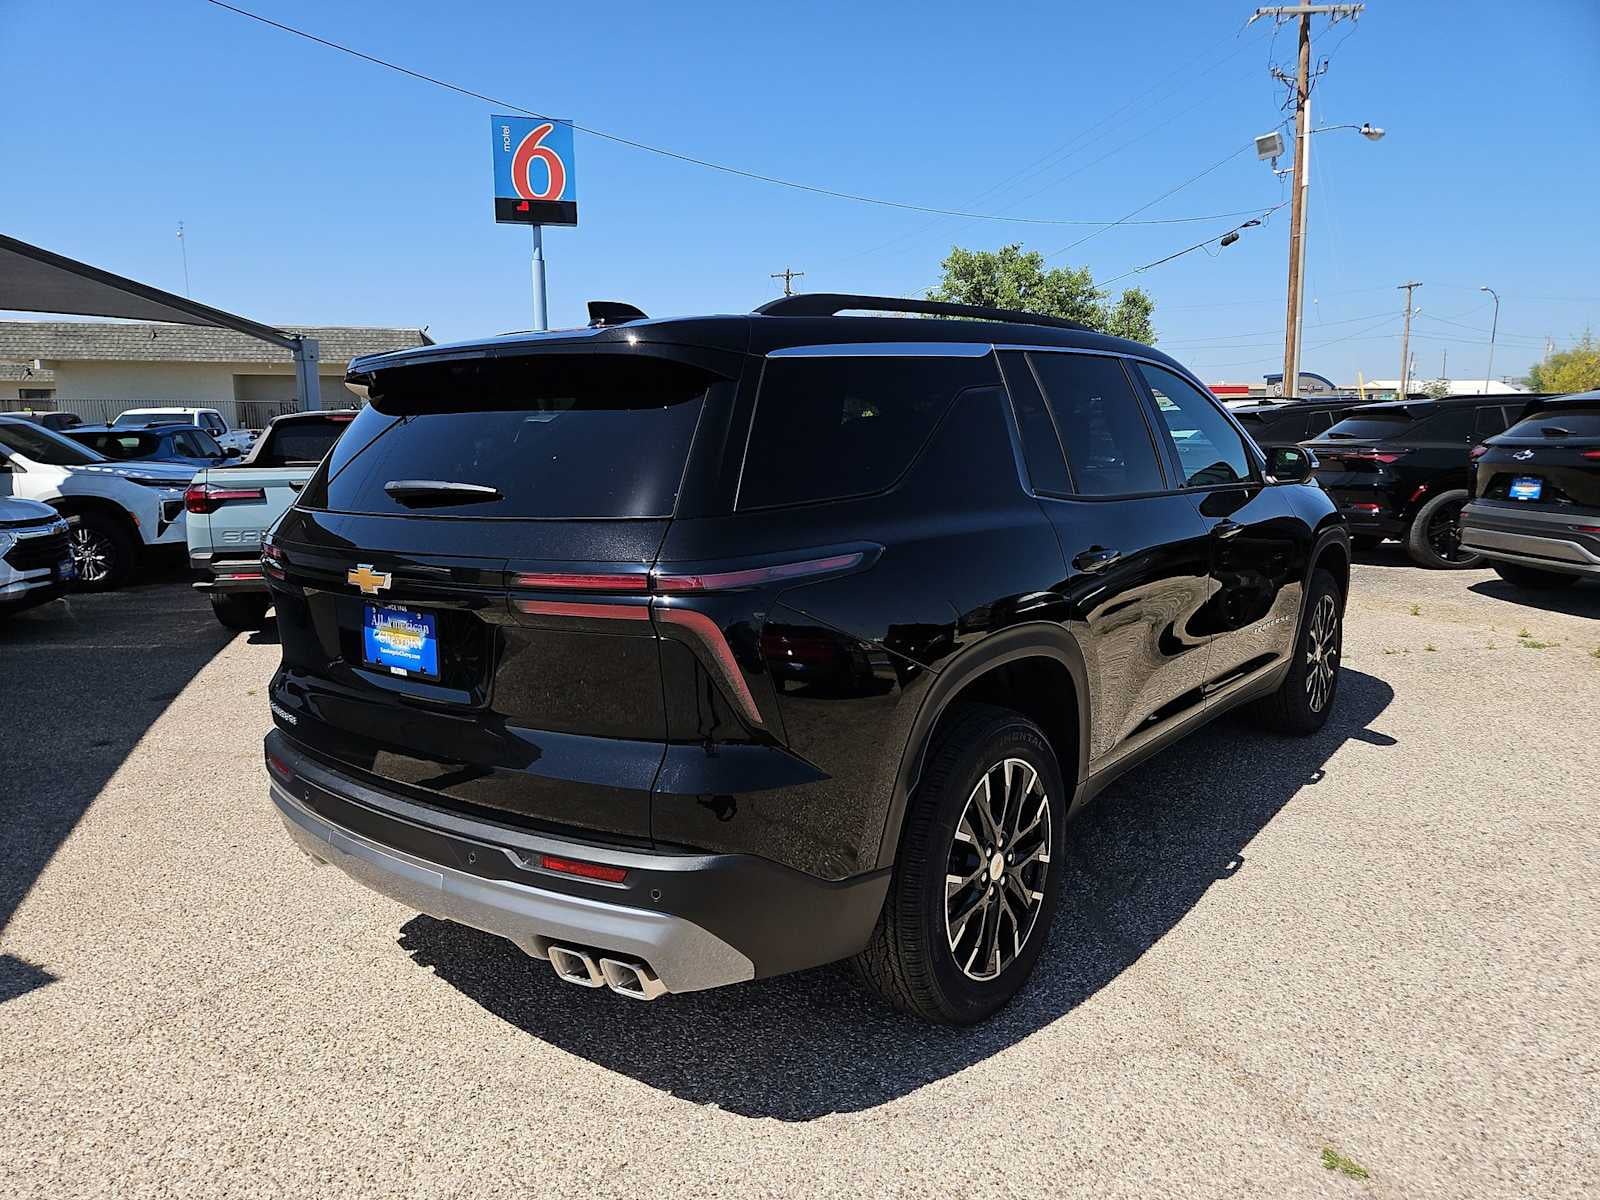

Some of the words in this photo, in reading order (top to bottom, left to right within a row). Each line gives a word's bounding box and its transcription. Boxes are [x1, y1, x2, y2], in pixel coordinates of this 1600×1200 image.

[501, 125, 512, 152] motel
[511, 123, 566, 200] 6
[222, 528, 262, 544] SA
[386, 614, 430, 634] American
